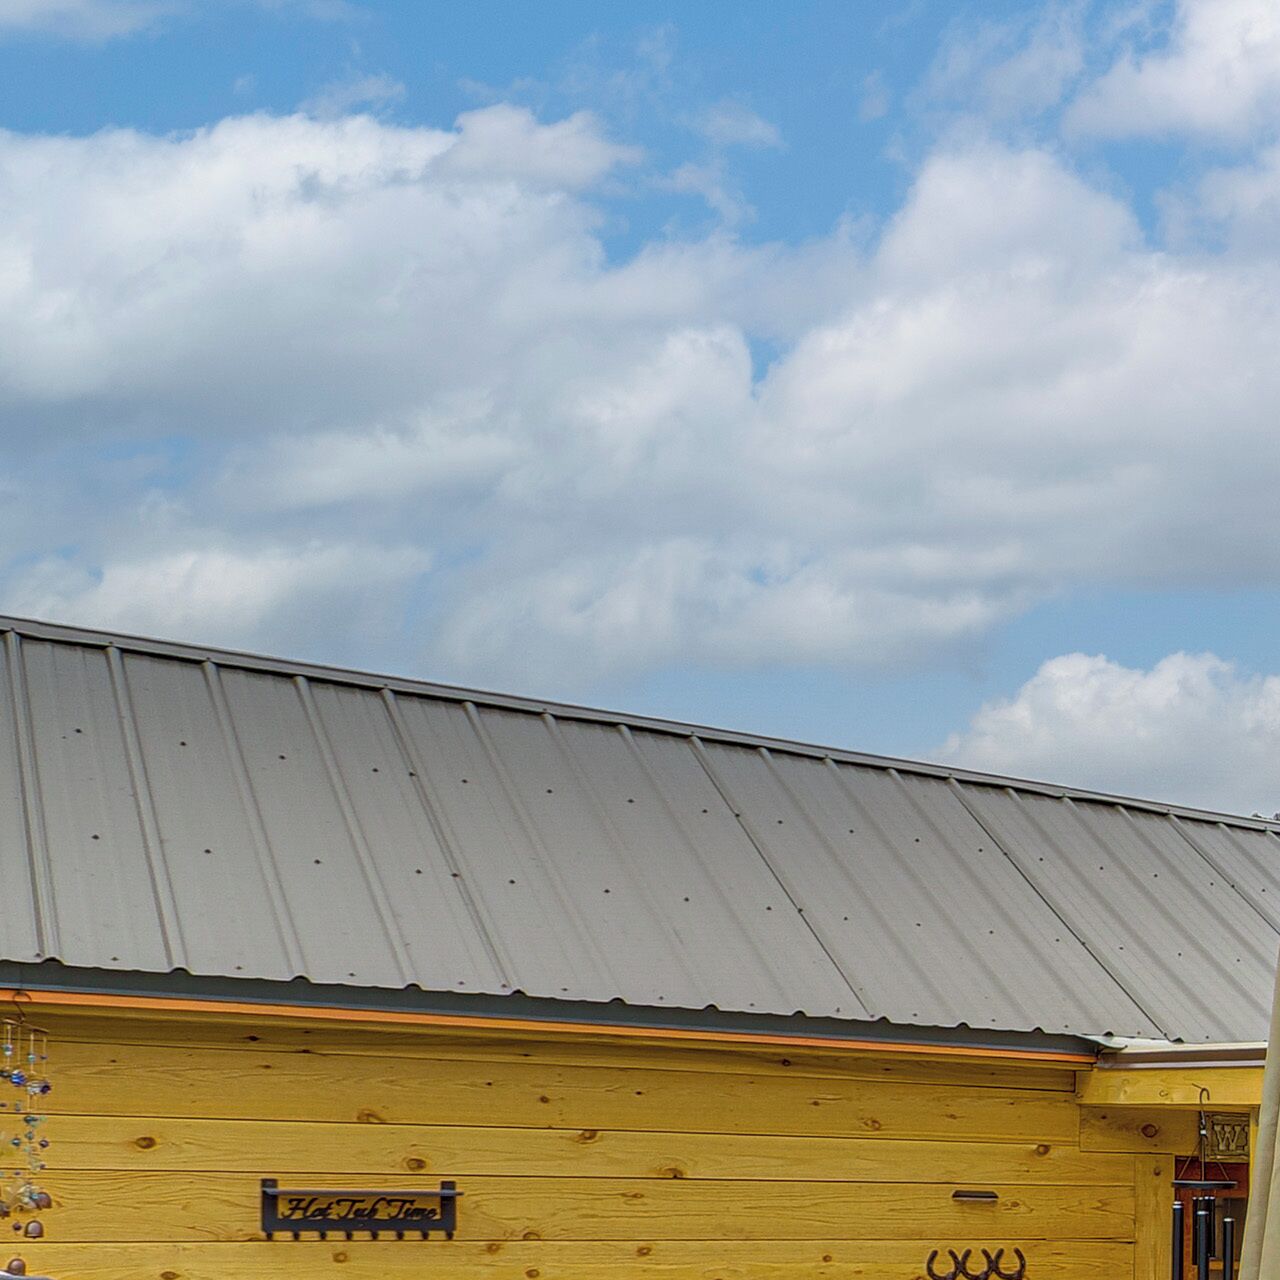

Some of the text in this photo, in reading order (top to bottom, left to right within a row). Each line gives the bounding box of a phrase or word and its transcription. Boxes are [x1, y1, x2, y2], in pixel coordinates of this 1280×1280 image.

[282, 1197, 438, 1219] Hot Tub Time
